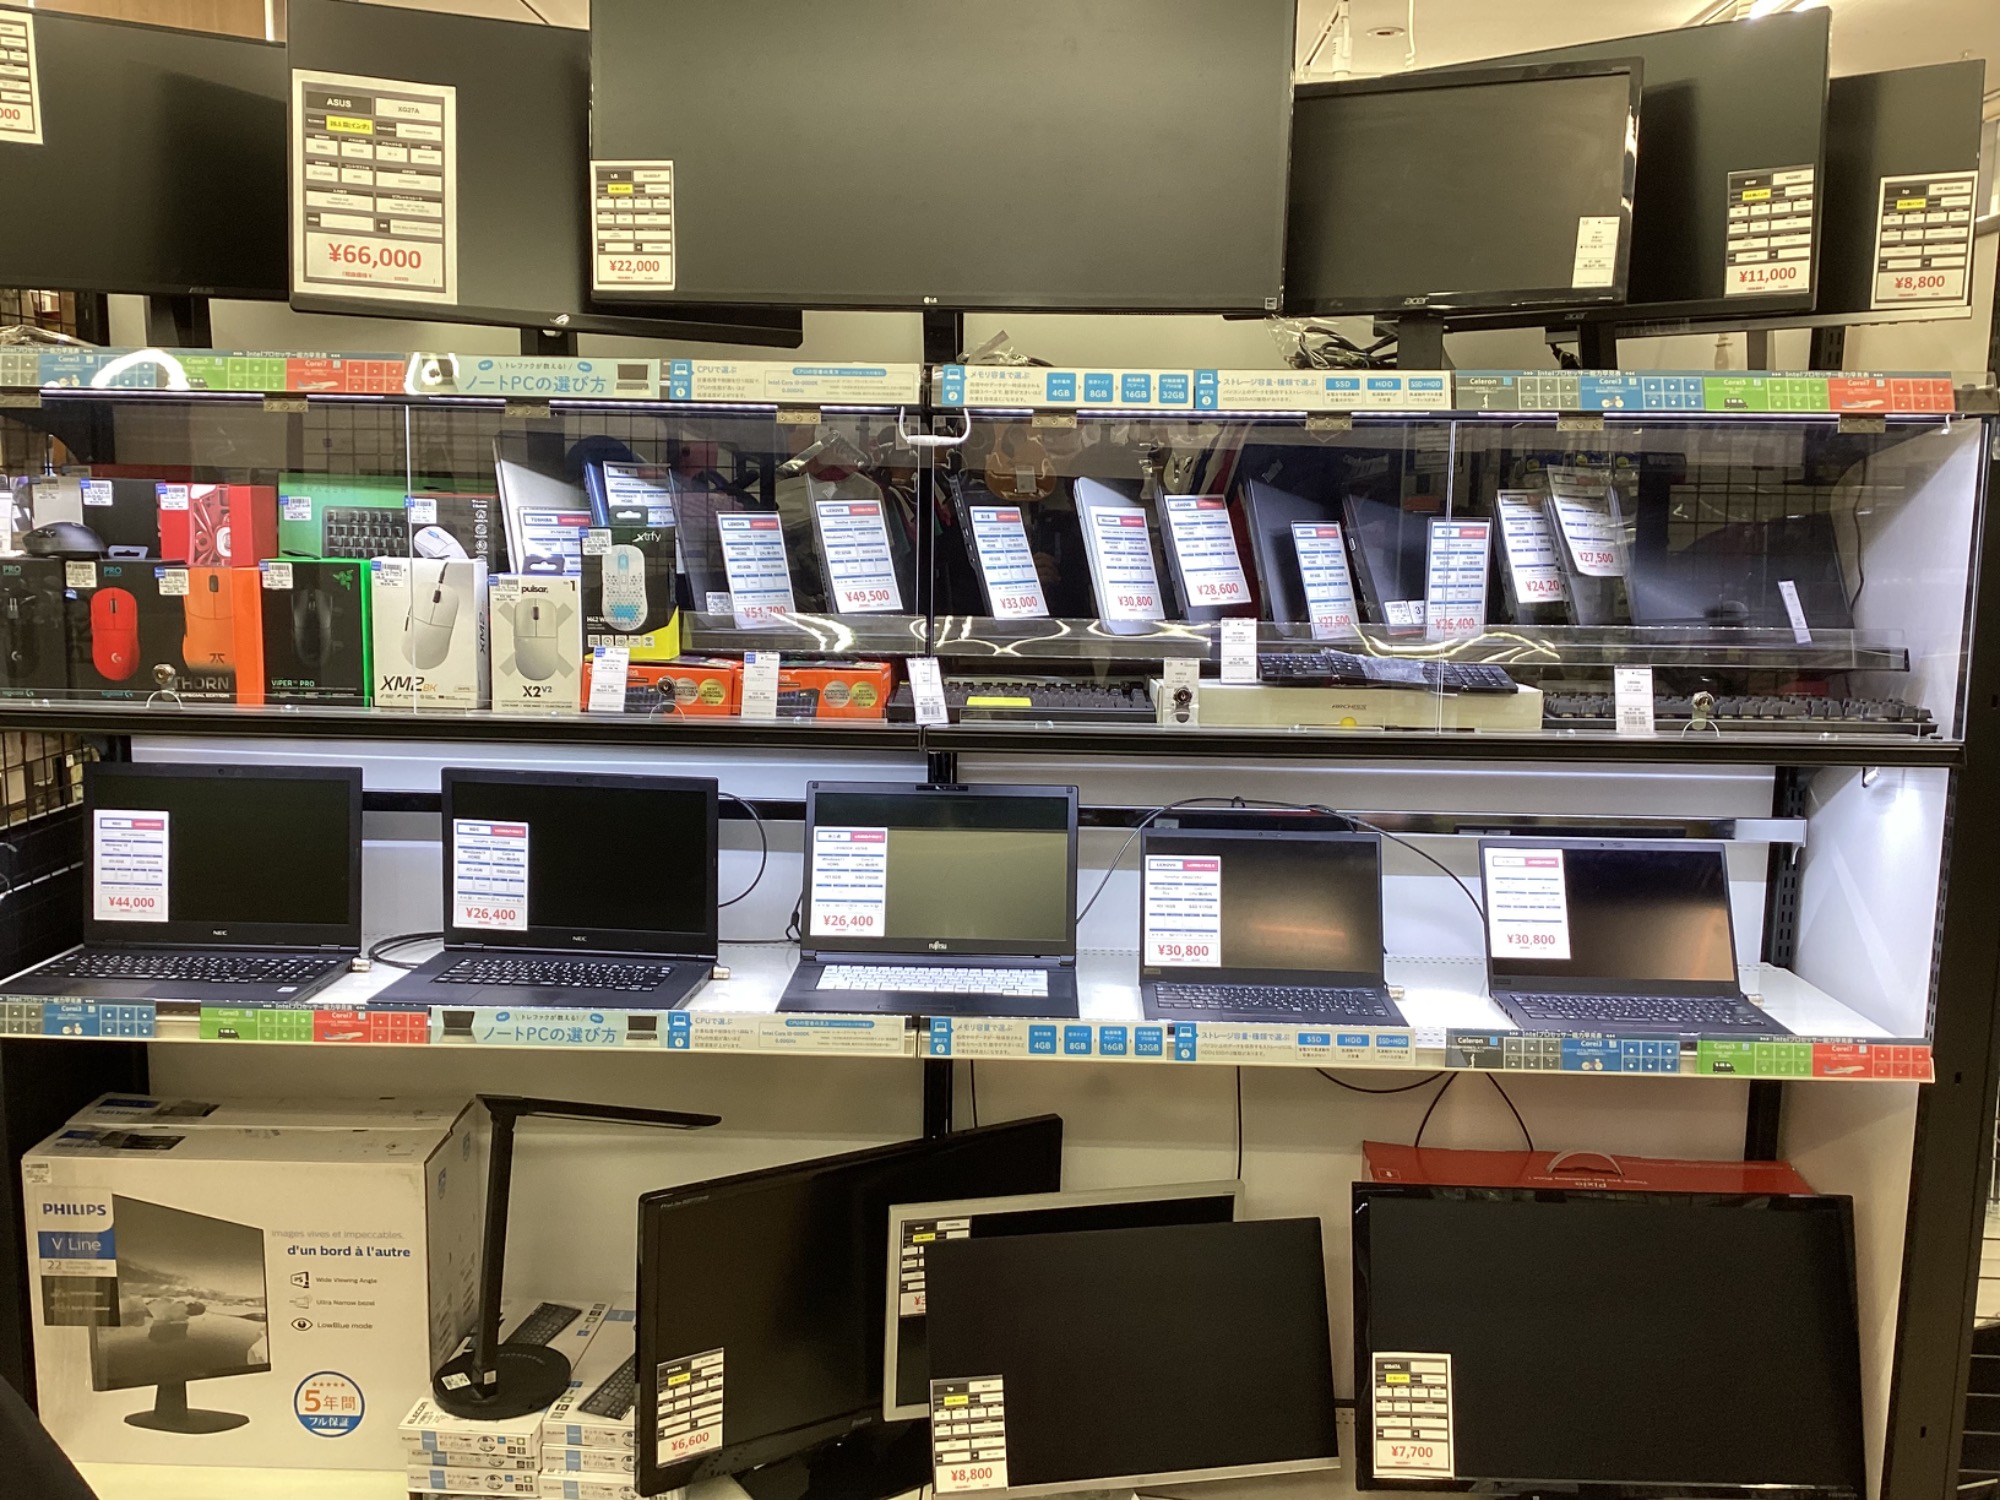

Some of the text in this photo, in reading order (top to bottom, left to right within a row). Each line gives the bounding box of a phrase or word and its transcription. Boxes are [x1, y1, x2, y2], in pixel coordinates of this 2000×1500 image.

[326, 97, 352, 108] ASUS
[328, 243, 421, 269] ¥66,000
[609, 260, 660, 274] ¥22,000
[1739, 267, 1797, 284] ¥11,000
[1895, 275, 1945, 291] ¥8,800
[969, 370, 1030, 380] メモリ容量で選ぶ
[466, 375, 607, 393] ノートPCの選び方
[1052, 389, 1070, 397] 4GB
[1089, 389, 1107, 398] 8GB
[1125, 390, 1147, 398] 16GB
[1162, 390, 1185, 399] 32GB
[632, 531, 662, 543] xtrfy
[1579, 551, 1614, 565] ¥27,500
[3, 565, 21, 575] PRO
[103, 566, 122, 577] PRO
[1197, 582, 1239, 596] ¥28,600
[1525, 580, 1560, 592] ¥24,20
[845, 589, 890, 604] ¥49,500
[1000, 596, 1038, 610] ¥33,000
[1117, 595, 1153, 607] ¥30,800
[380, 675, 425, 692] XM2
[522, 685, 542, 698] X2
[108, 896, 155, 908] ¥44,000
[466, 907, 516, 921] ¥26,400
[823, 914, 874, 928] ¥26,400
[1507, 933, 1556, 946] ¥30,800
[1158, 944, 1209, 958] ¥30,800
[956, 1023, 1013, 1032] メモリ容量で選ぶ
[483, 1026, 617, 1043] ノートPCの選び方
[1034, 1042, 1051, 1050] 4GB
[1069, 1042, 1087, 1050] 8GB
[1103, 1043, 1124, 1051] 16GB
[1138, 1043, 1159, 1052] 32GB
[42, 1203, 107, 1216] PHILIPS
[307, 1230, 331, 1238] vives
[51, 1238, 102, 1251] V Line
[287, 1244, 411, 1258] d'un bord à l'autre
[47, 1260, 62, 1270] 22
[304, 1389, 356, 1413] 5年間
[308, 1417, 349, 1427] フル保証
[671, 1431, 709, 1452] ¥6,600
[1391, 1446, 1433, 1459] ¥7,700
[951, 1467, 992, 1482] ¥8,800
